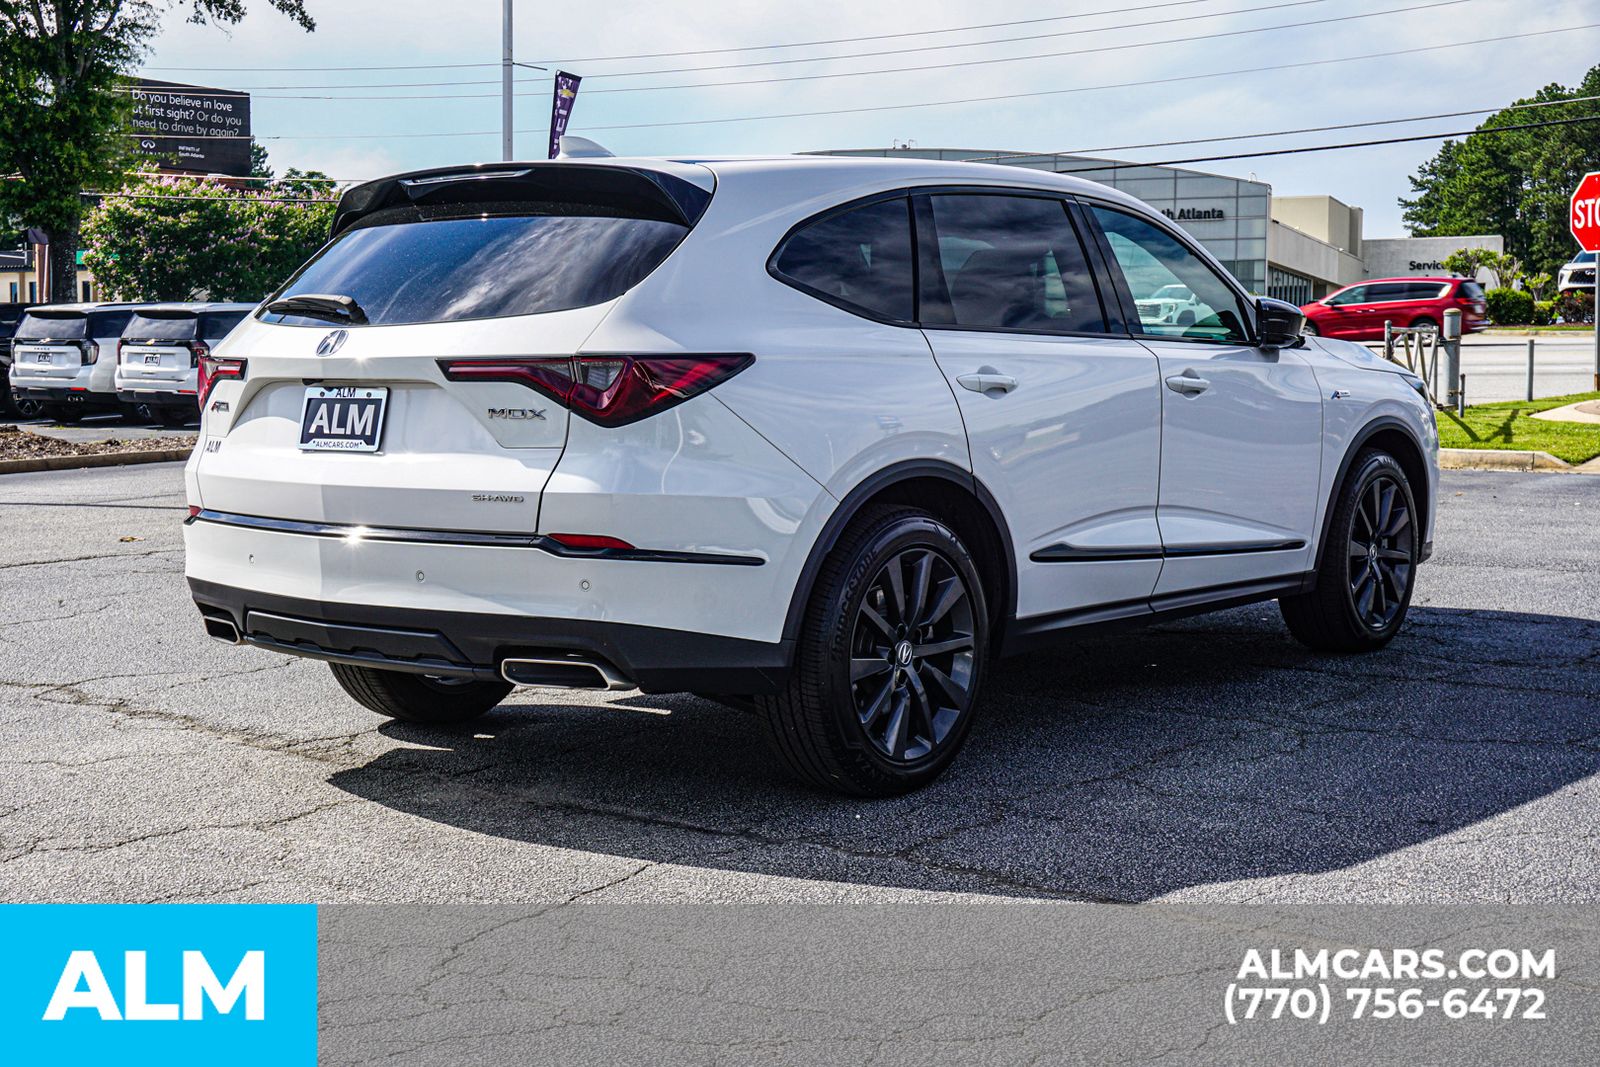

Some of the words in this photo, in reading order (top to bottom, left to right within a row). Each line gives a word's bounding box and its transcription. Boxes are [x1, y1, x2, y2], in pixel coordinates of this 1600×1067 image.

[149, 94, 166, 104] you
[169, 94, 201, 108] believe
[203, 99, 212, 108] in
[214, 100, 233, 112] love
[145, 105, 165, 117] first
[166, 109, 195, 121] sight?
[197, 111, 209, 122] Or
[211, 113, 223, 124] do
[225, 116, 242, 126] you
[132, 119, 156, 129] need
[159, 121, 169, 131] to
[171, 122, 194, 133] drive
[196, 124, 208, 136] by
[209, 128, 239, 137] again?
[1177, 208, 1224, 220] Atlanta
[1573, 197, 1600, 229] STO
[1409, 260, 1445, 271] Servic
[335, 387, 356, 398] ALM
[308, 403, 376, 436] ALM
[487, 408, 547, 421] MDX
[206, 440, 222, 453] ALM
[314, 440, 360, 449] ALMCARS.COM
